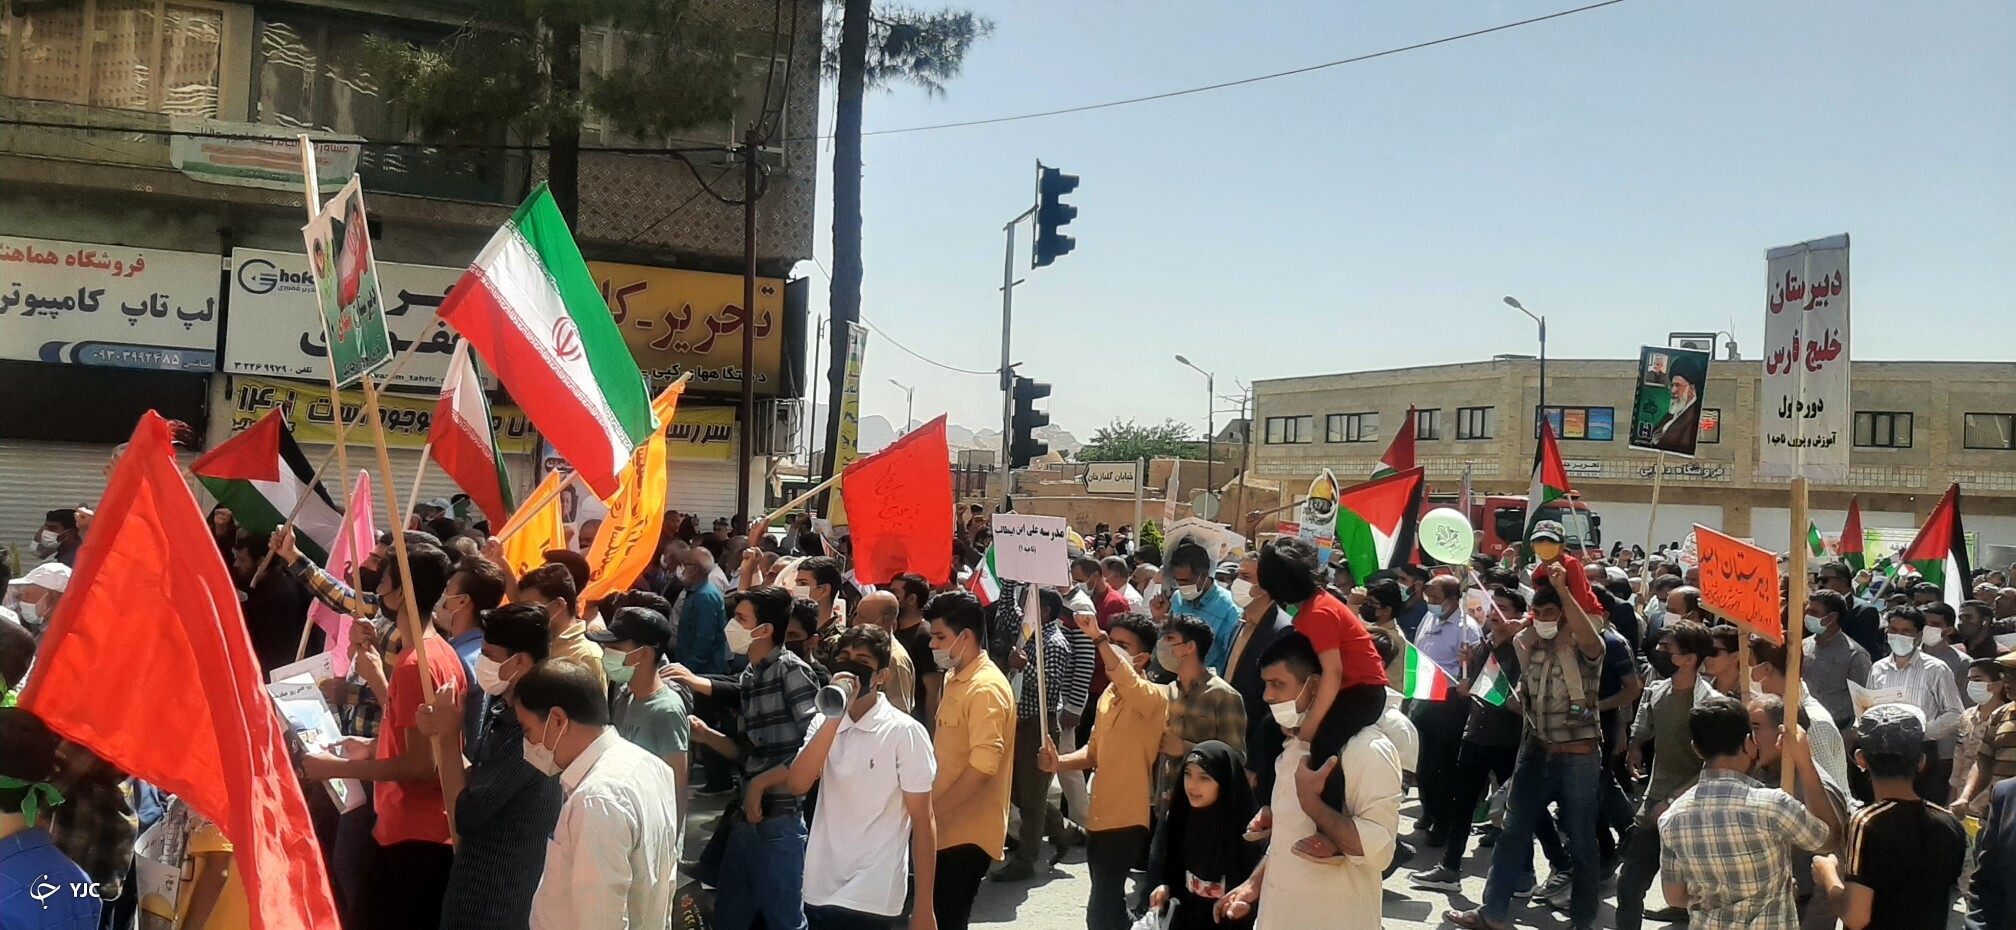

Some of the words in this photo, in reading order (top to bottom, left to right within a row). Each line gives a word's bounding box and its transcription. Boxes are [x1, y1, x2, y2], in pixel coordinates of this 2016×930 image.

[0, 243, 58, 265] هماهن
[65, 249, 145, 277] فروشگاه
[0, 282, 105, 319] کامپیوتر
[1770, 269, 1842, 314] دبیرستان
[121, 293, 169, 326] تاپ
[176, 296, 215, 331] لپ
[1767, 328, 1800, 374] فارس
[1805, 328, 1842, 372] خلیج
[652, 363, 681, 382] کپی
[1796, 397, 1823, 418] دوره
[667, 423, 733, 446] سررس
[1812, 431, 1837, 448] آموزش
[1114, 471, 1134, 483] خیابان
[1675, 462, 1725, 478] فروشگاه
[1016, 523, 1026, 535] ابن
[1027, 523, 1038, 536] علی
[1040, 527, 1065, 541] مدرسه
[1721, 551, 1769, 602] دبیرستان
